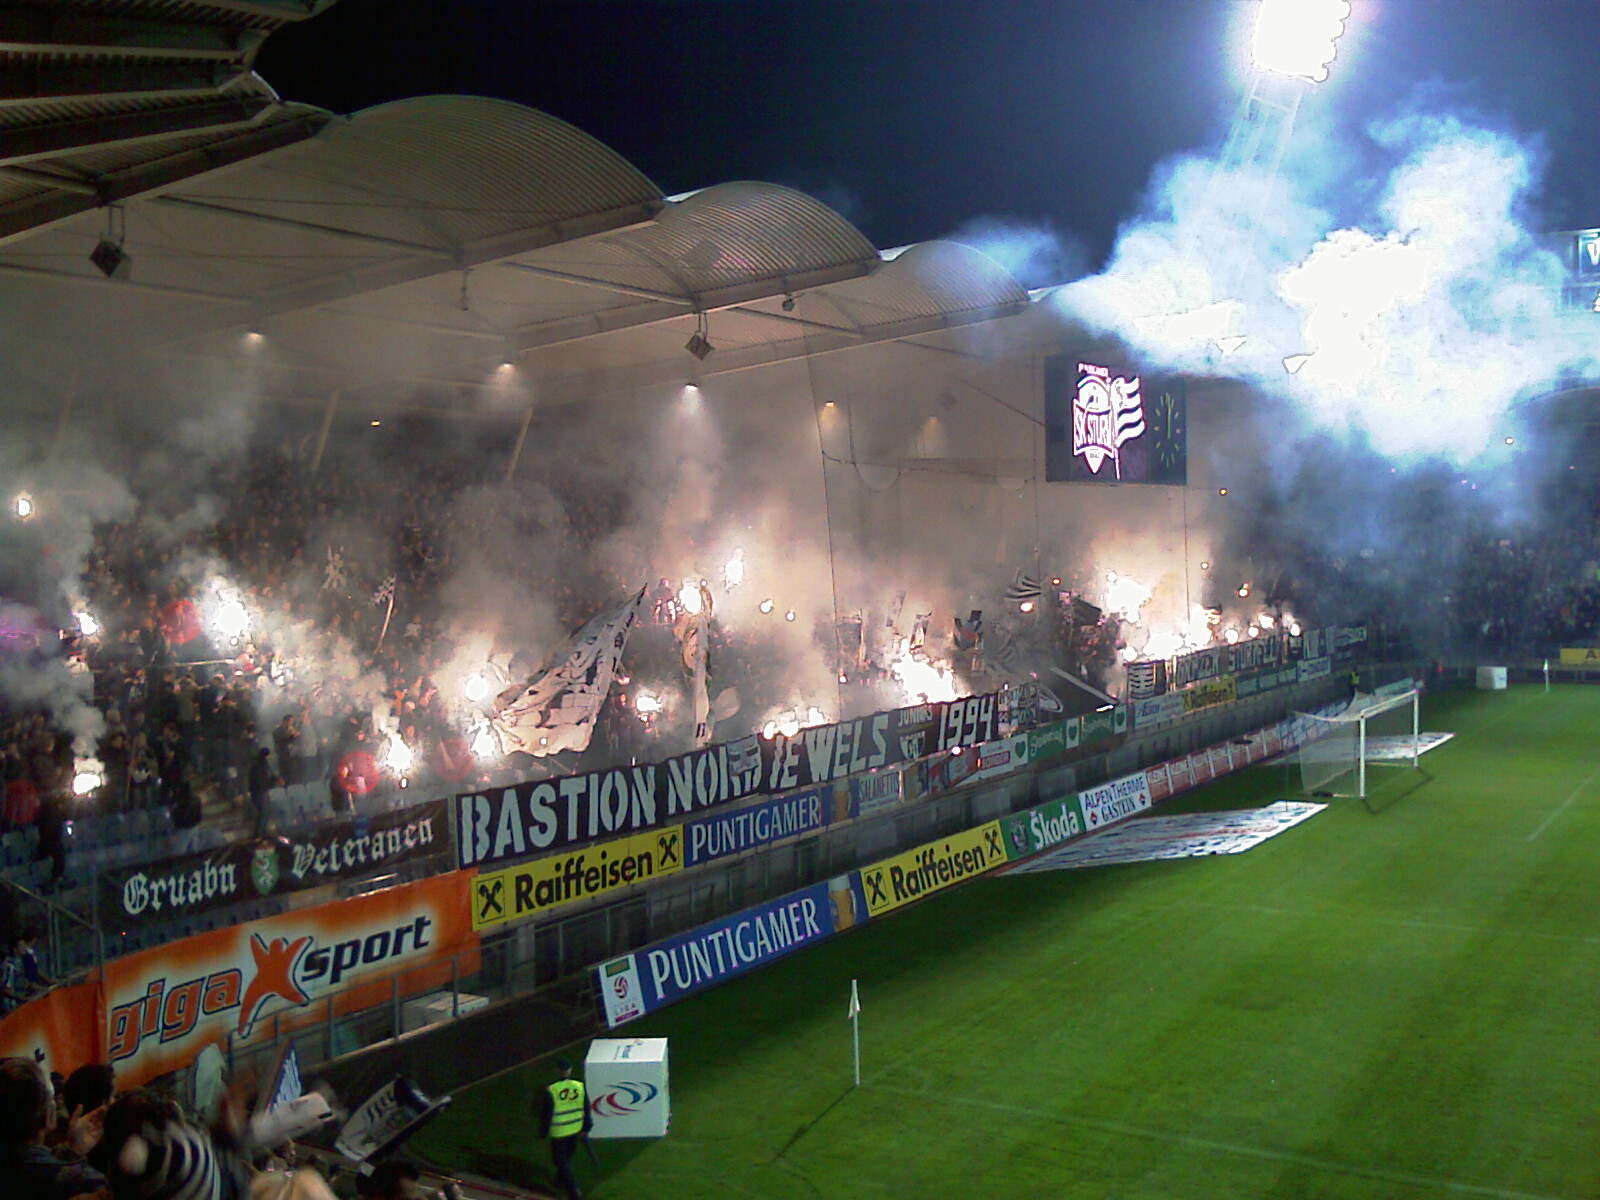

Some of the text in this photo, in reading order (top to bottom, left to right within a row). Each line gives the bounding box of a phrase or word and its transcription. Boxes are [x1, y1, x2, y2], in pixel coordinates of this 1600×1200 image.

[461, 766, 656, 864] BASTION
[937, 696, 994, 750] 1994
[123, 816, 434, 915] Gruabn Veteranen
[692, 795, 820, 861] PUNTIGAMER
[1030, 803, 1079, 849] Škoda
[516, 850, 653, 913] Raiffeisen
[891, 843, 986, 901] Raiffeisen
[106, 916, 432, 1061] giga sport
[648, 898, 820, 999] PUNTIGAMER
